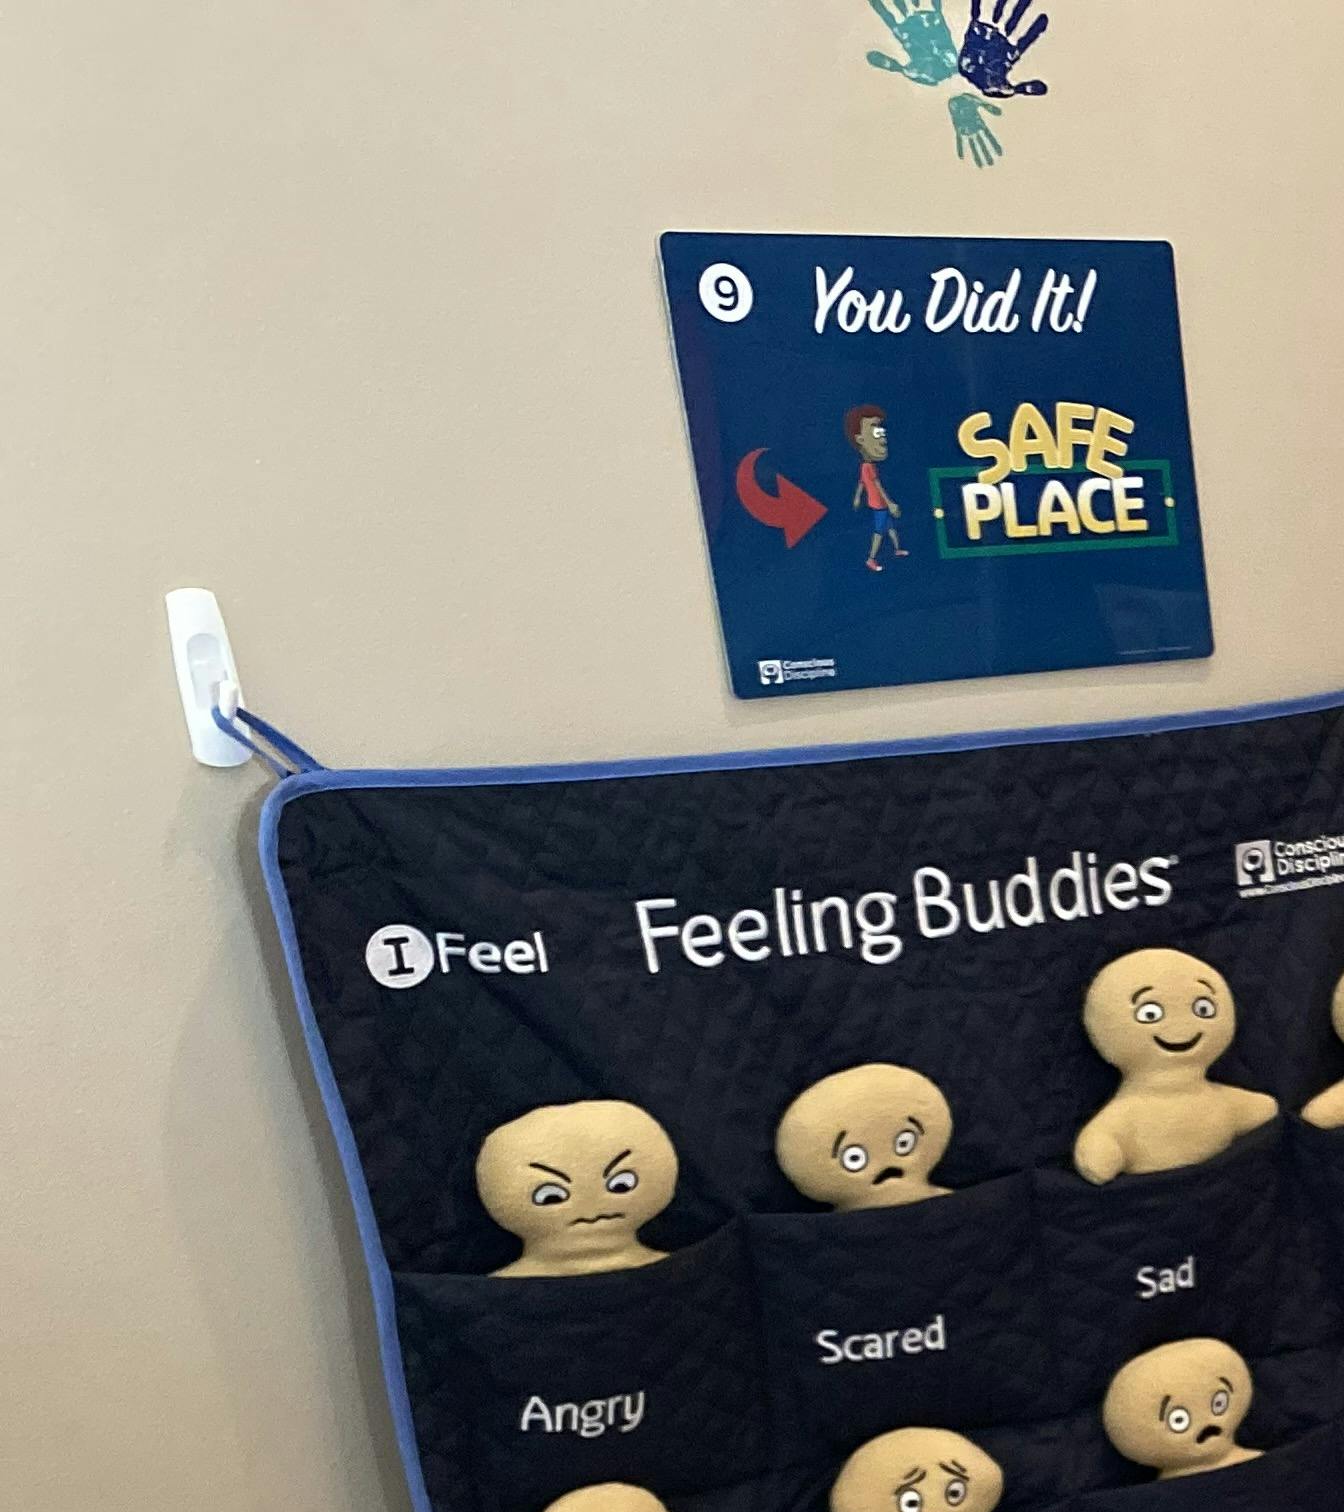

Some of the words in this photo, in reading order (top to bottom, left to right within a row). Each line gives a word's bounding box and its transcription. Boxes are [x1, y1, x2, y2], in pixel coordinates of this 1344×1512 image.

[712, 275, 738, 312] 9
[811, 265, 911, 335] You
[925, 266, 1021, 334] Did
[1032, 268, 1098, 334] It!
[957, 401, 1136, 485] SAFE
[961, 476, 1149, 541] PLACE
[434, 932, 549, 976] Feel
[633, 886, 904, 976] Feeling
[1135, 1256, 1196, 1300] Sad
[815, 1315, 947, 1366] Scared
[520, 1391, 646, 1438] Angry
